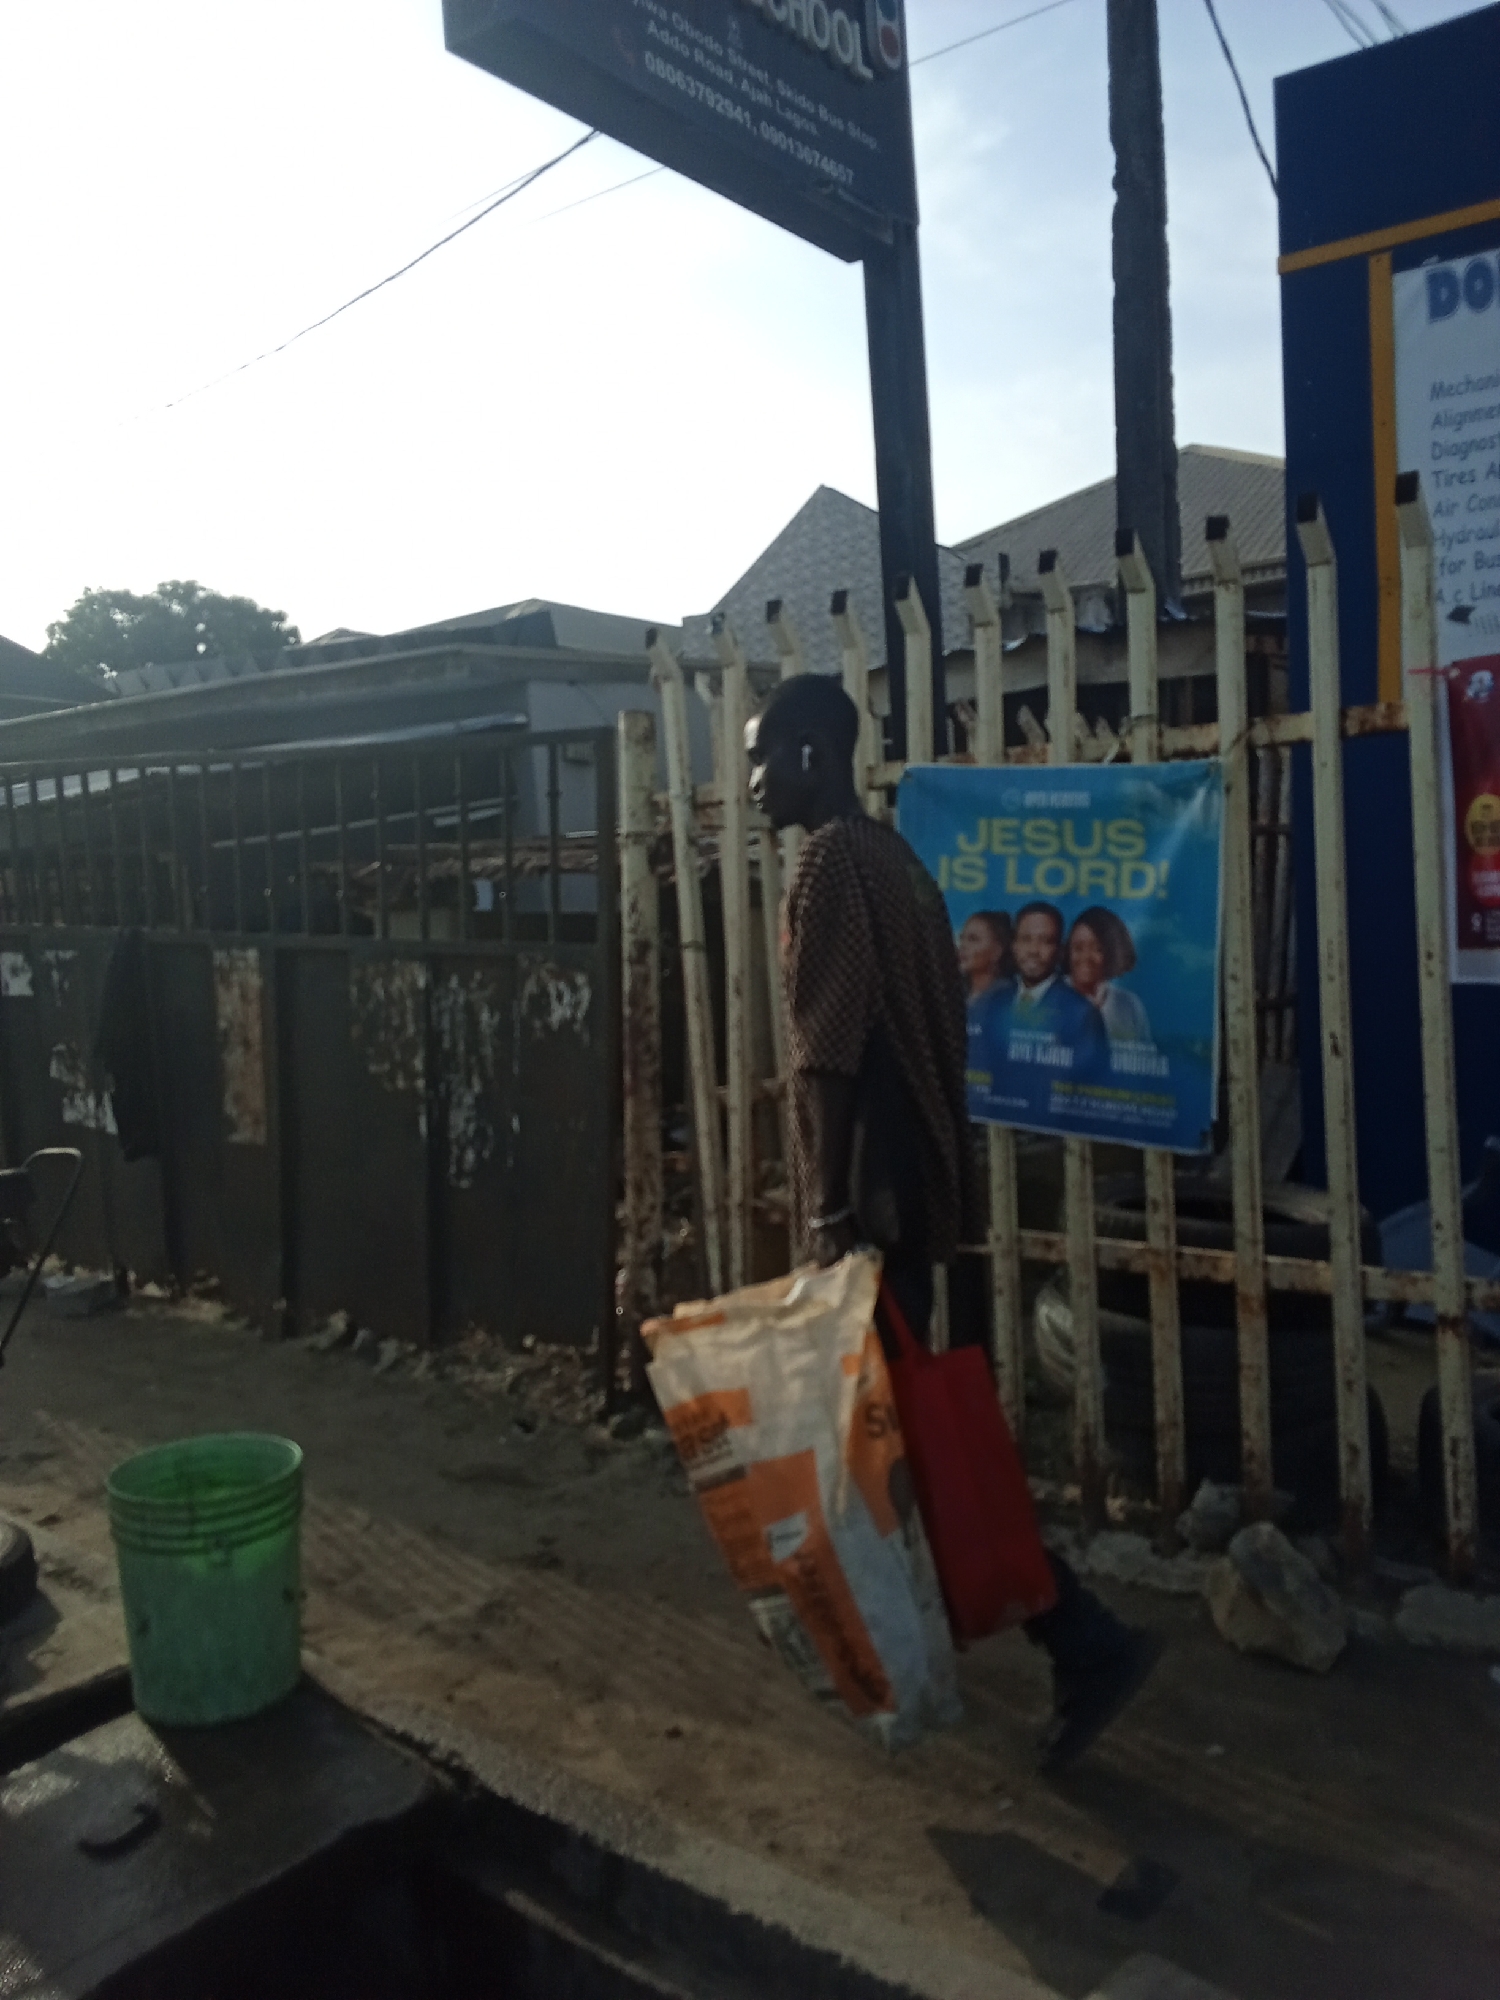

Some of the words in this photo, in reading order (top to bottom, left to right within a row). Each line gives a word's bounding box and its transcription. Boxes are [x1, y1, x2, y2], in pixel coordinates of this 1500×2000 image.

[1431, 468, 1476, 488] Tires
[1433, 498, 1460, 518] Air
[1440, 556, 1466, 577] for
[956, 817, 1147, 859] JESUS
[937, 854, 989, 893] IS
[1004, 856, 1170, 900] LORD!
